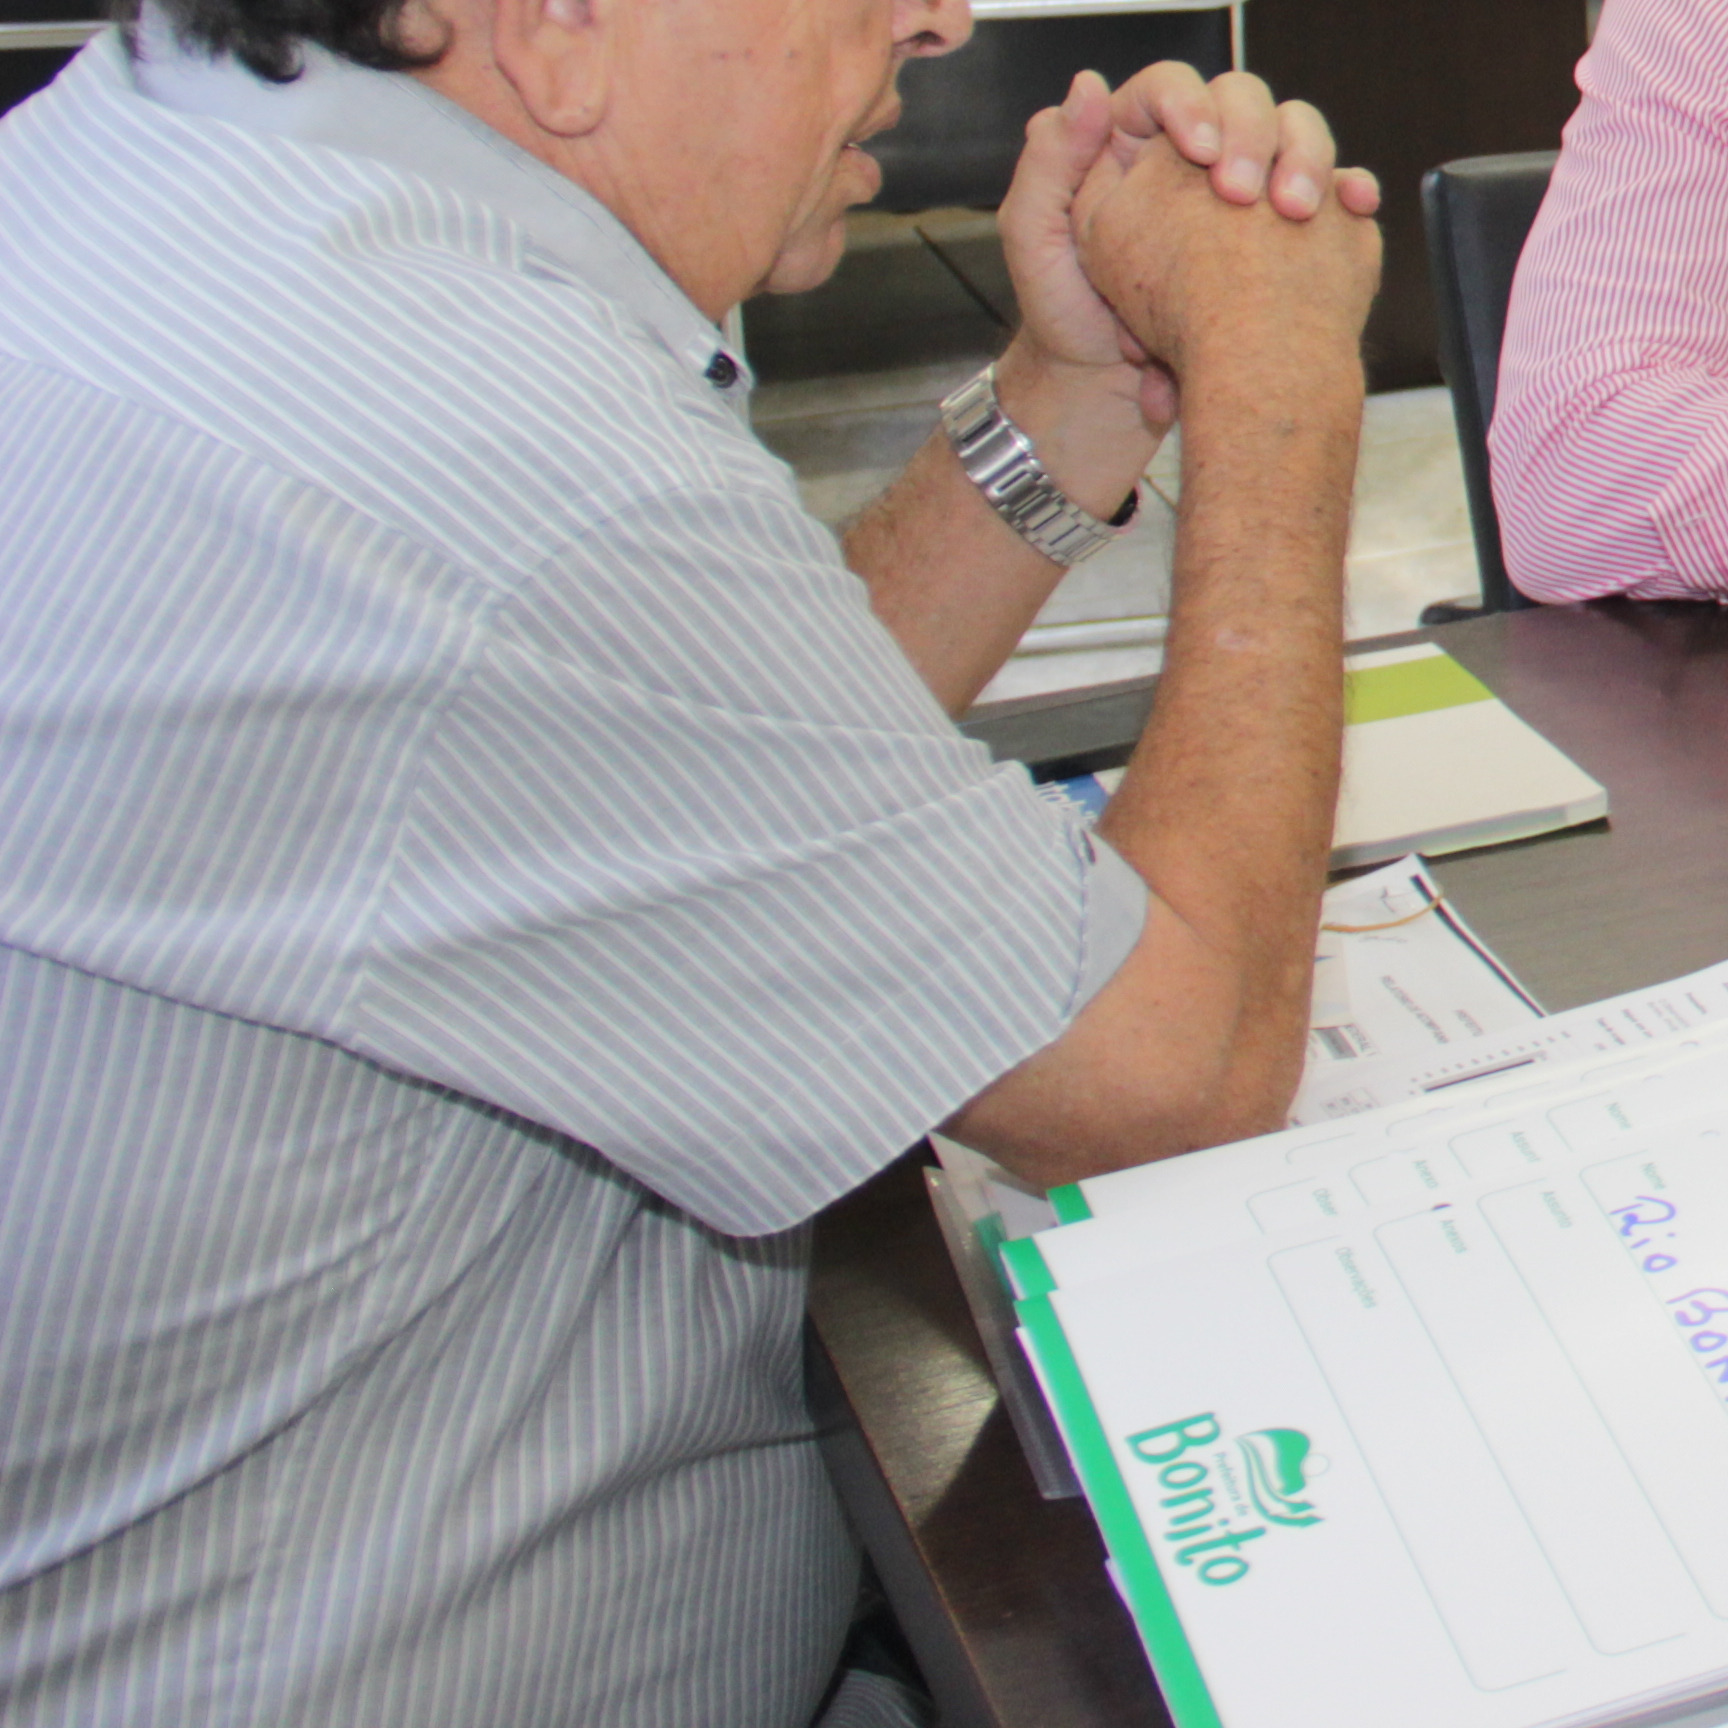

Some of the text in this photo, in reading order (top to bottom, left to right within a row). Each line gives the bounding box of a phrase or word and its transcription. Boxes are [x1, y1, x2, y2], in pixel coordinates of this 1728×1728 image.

[1511, 1131, 1541, 1163] Assunt
[1412, 1159, 1439, 1189] Anexo
[1640, 1162, 1666, 1191] Nome
[1541, 1190, 1573, 1229] Assunto
[1441, 1219, 1468, 1255] Anexos
[1335, 1246, 1377, 1309] Observações
[1124, 1411, 1267, 1587] Bonito
[1213, 1451, 1249, 1517] Prefeitura de
